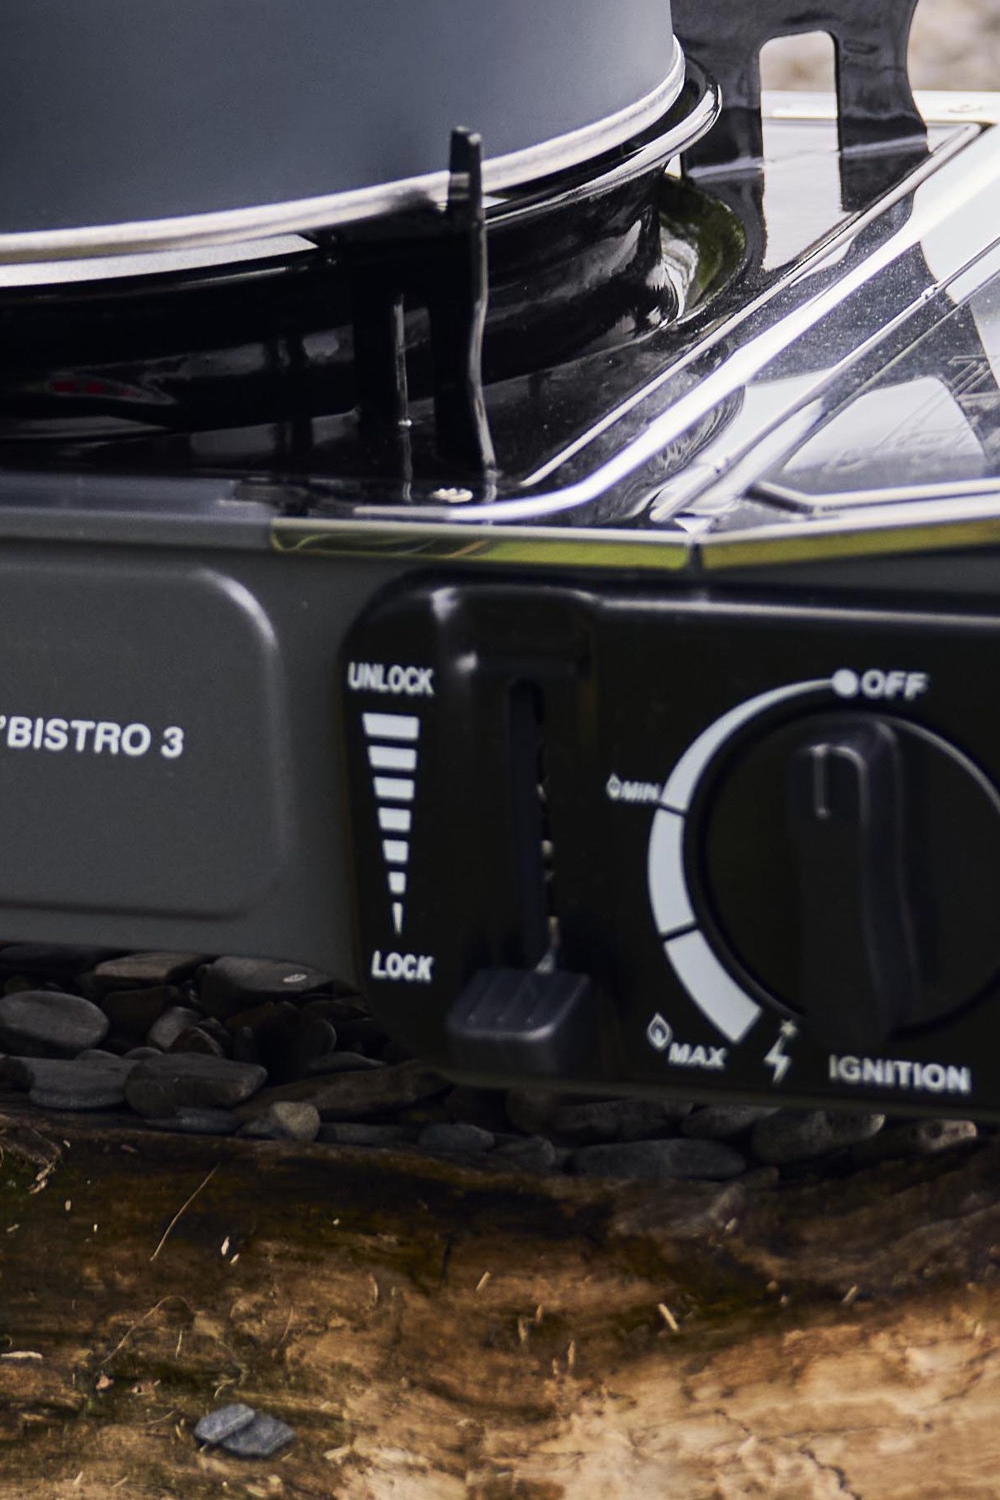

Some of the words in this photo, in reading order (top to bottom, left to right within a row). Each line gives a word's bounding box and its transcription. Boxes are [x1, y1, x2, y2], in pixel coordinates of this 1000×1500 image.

[347, 661, 434, 695] UNLOCK
[861, 669, 927, 698] OFF
[160, 726, 184, 759] 3
[620, 780, 660, 803] MIN
[371, 951, 433, 982] LOCK
[668, 1042, 725, 1068] MAX
[829, 1055, 971, 1093] IGNITION
